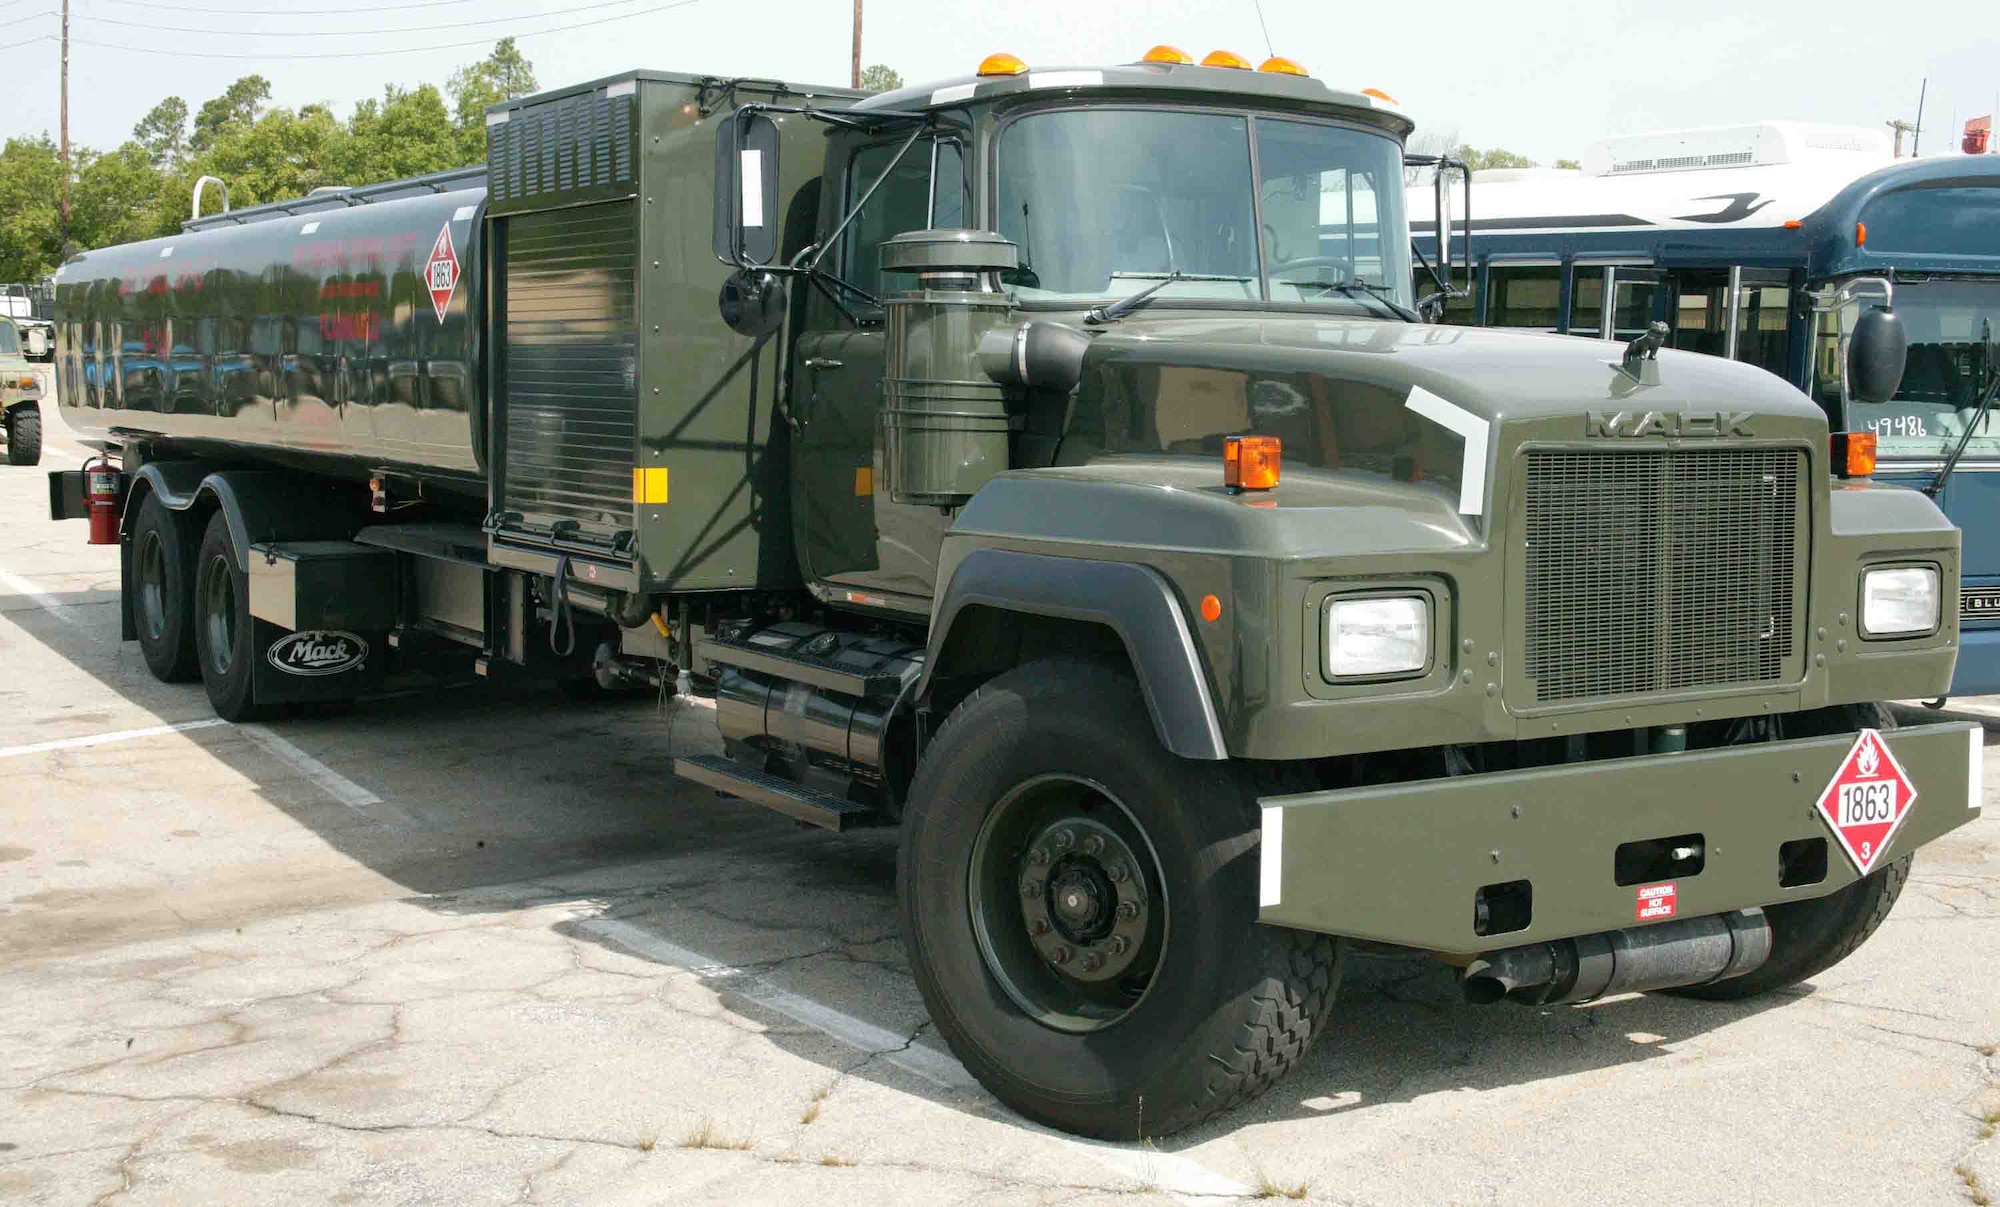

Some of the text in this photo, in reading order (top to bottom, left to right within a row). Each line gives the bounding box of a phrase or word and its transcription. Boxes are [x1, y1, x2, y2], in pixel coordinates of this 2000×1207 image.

[433, 263, 450, 289] 1863
[439, 302, 444, 314] 3
[1586, 410, 1754, 437] MACK
[287, 639, 351, 663] Mack
[1843, 783, 1890, 823] 1863
[1861, 841, 1871, 859] 3
